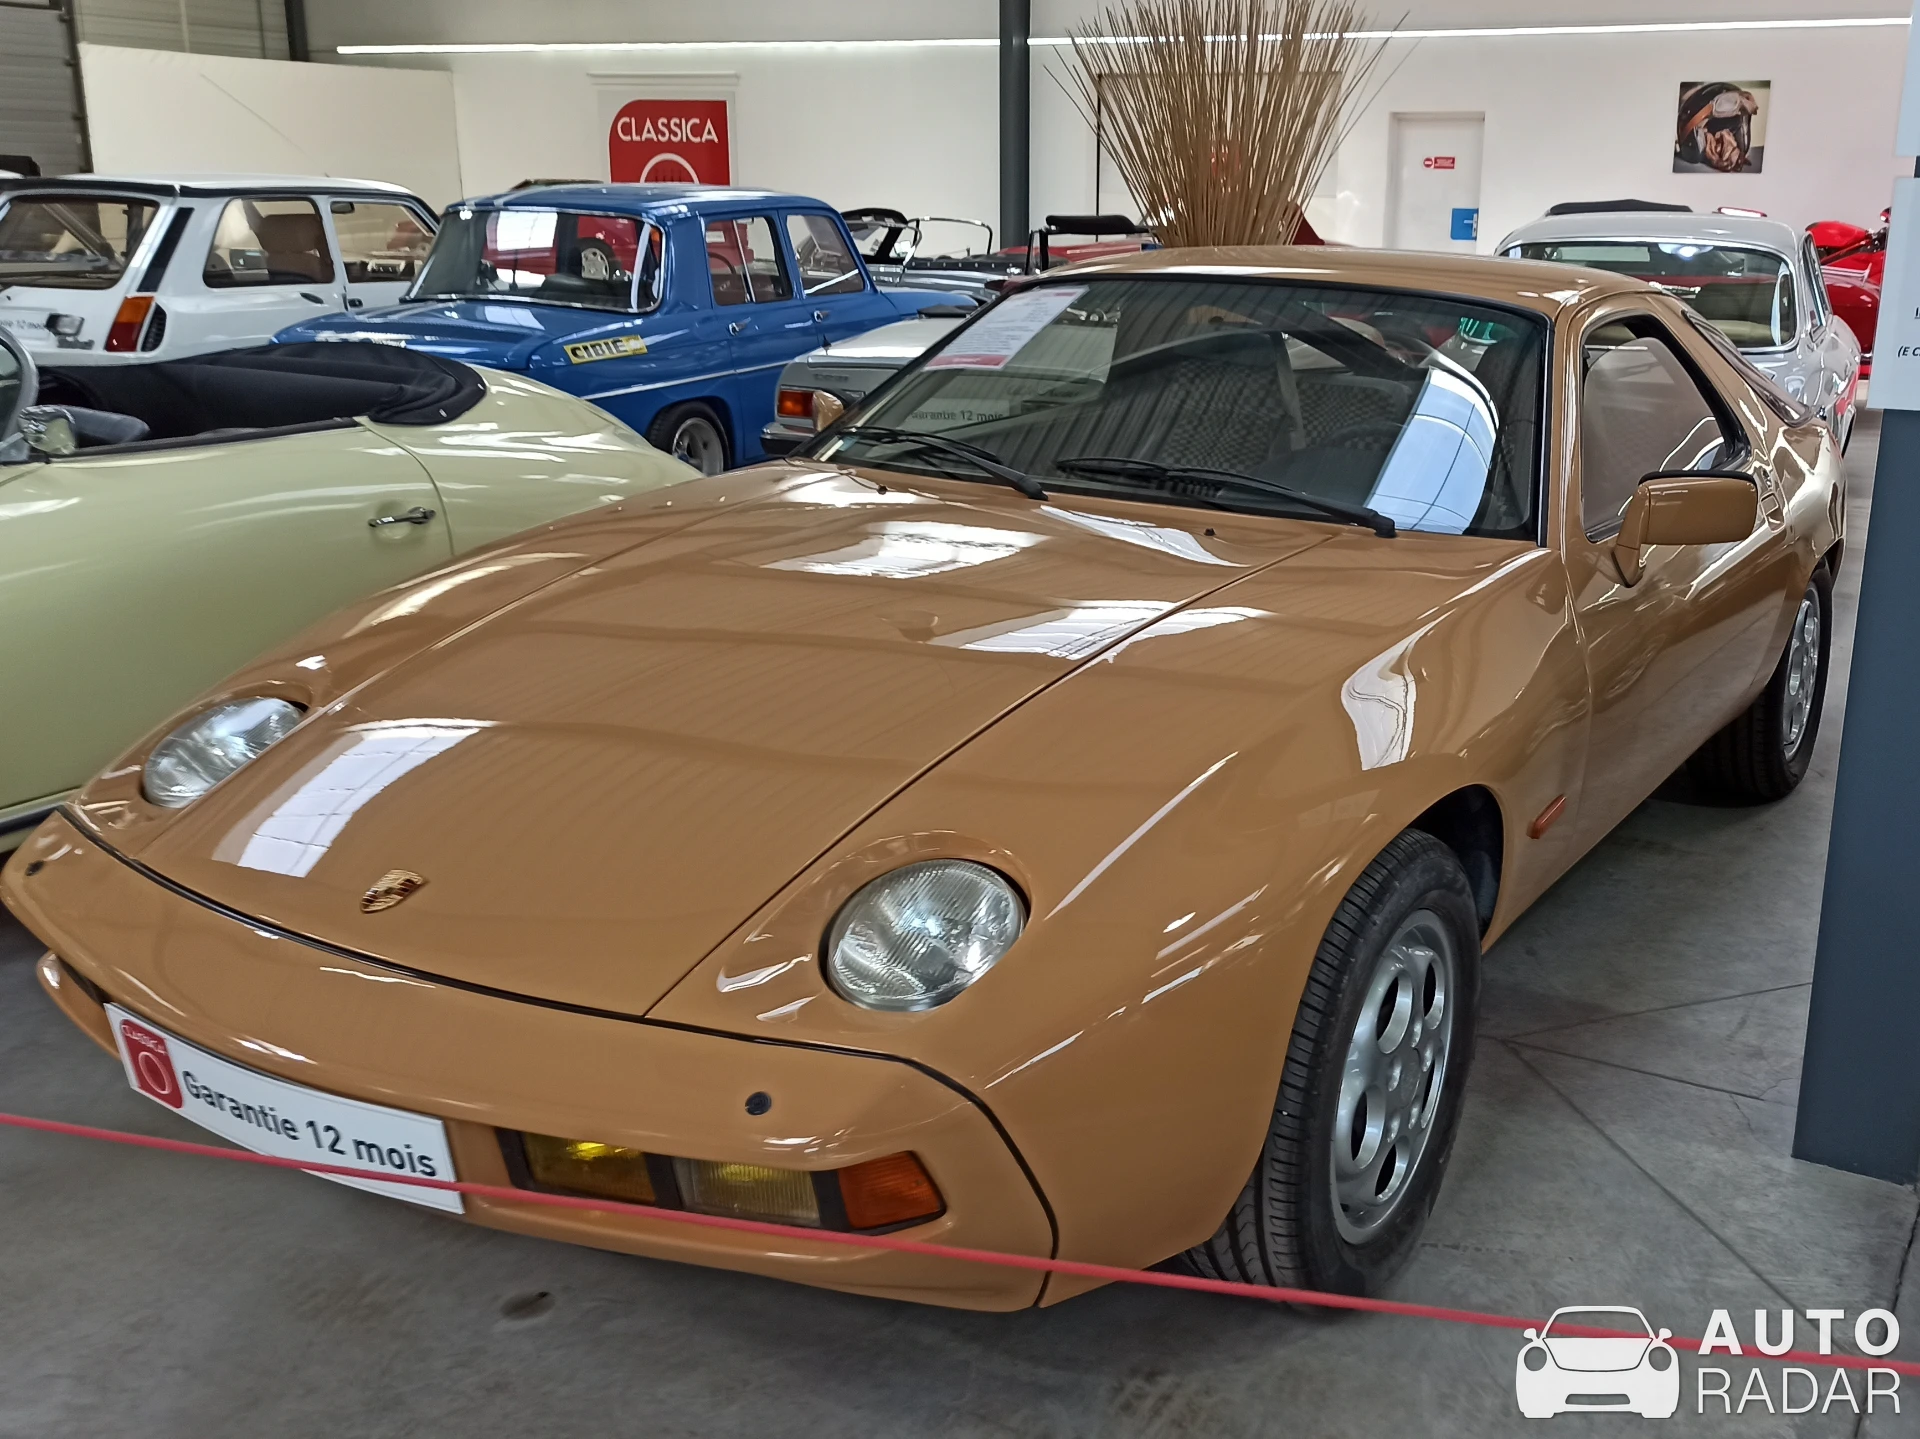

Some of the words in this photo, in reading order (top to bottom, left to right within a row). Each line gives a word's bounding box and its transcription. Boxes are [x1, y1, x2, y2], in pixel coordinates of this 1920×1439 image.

[617, 117, 719, 143] CLASSICA
[960, 410, 973, 421] 12
[181, 1070, 300, 1140] Garantie
[305, 1120, 346, 1155] 12
[352, 1138, 437, 1177] mois
